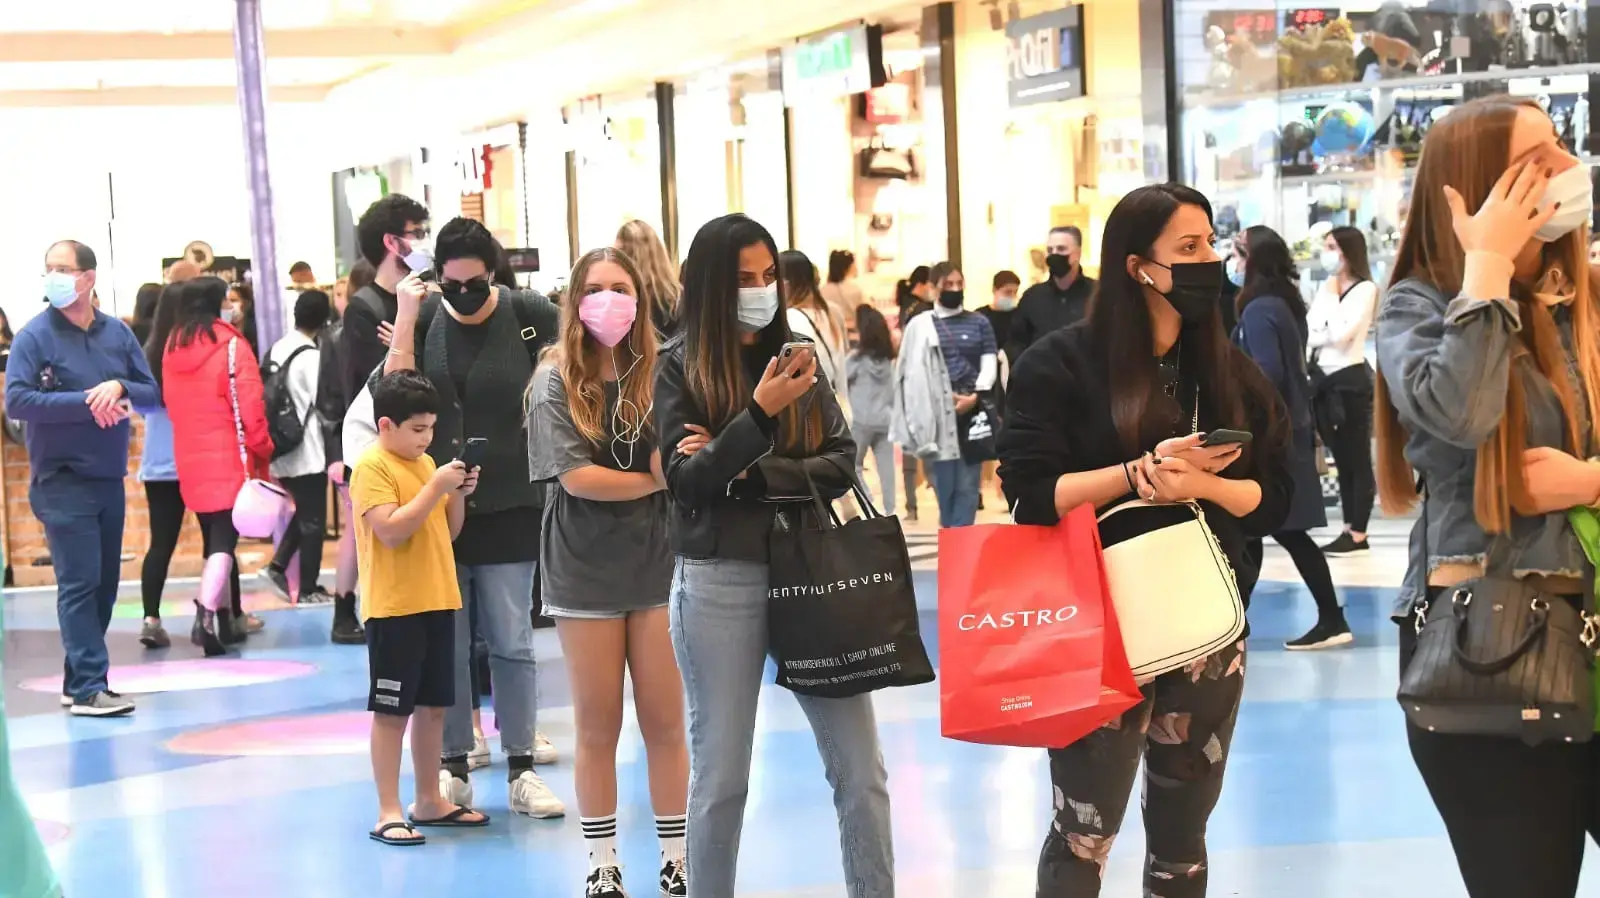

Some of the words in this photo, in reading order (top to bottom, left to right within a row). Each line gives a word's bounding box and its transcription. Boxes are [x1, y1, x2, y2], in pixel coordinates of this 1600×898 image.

[958, 605, 1078, 631] CASTRO
[847, 649, 867, 662] SHOP
[868, 642, 897, 656] ONLINE
